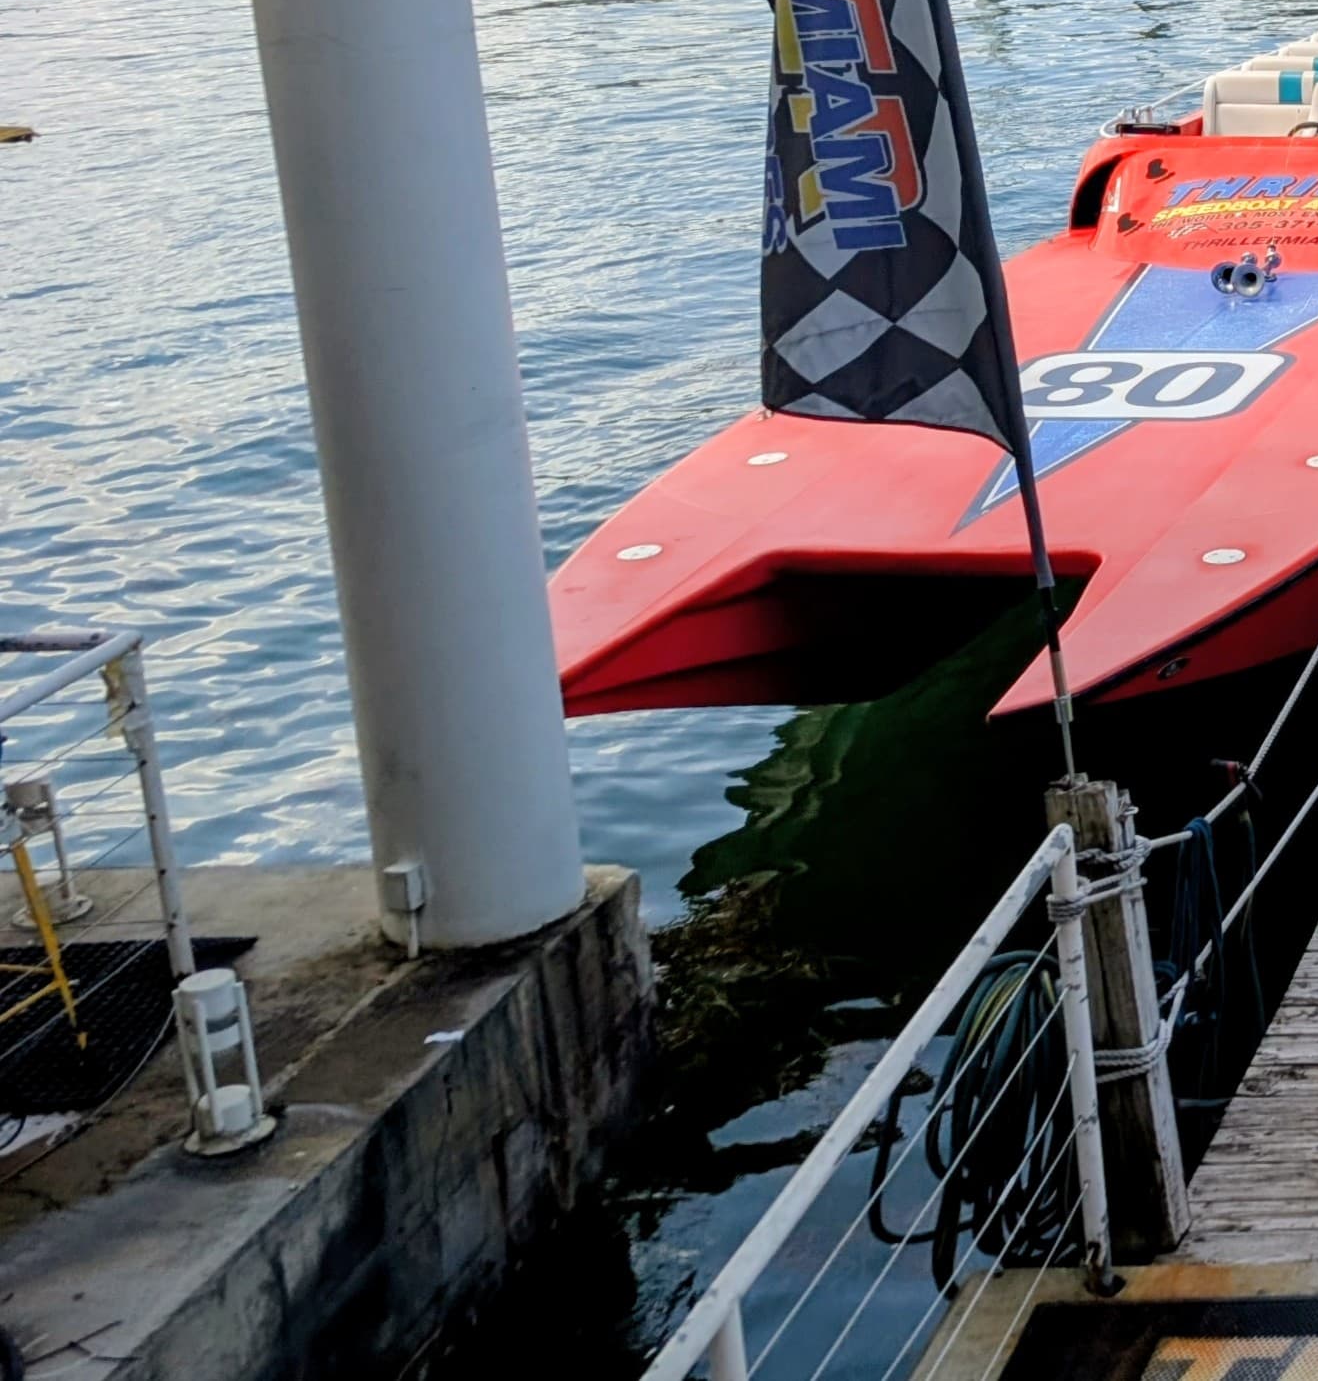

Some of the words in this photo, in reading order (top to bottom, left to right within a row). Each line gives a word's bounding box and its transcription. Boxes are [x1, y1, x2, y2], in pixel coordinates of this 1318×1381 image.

[1152, 199, 1299, 223] SPEEDBOAT
[1255, 210, 1297, 219] MOST
[1023, 361, 1245, 407] 80
